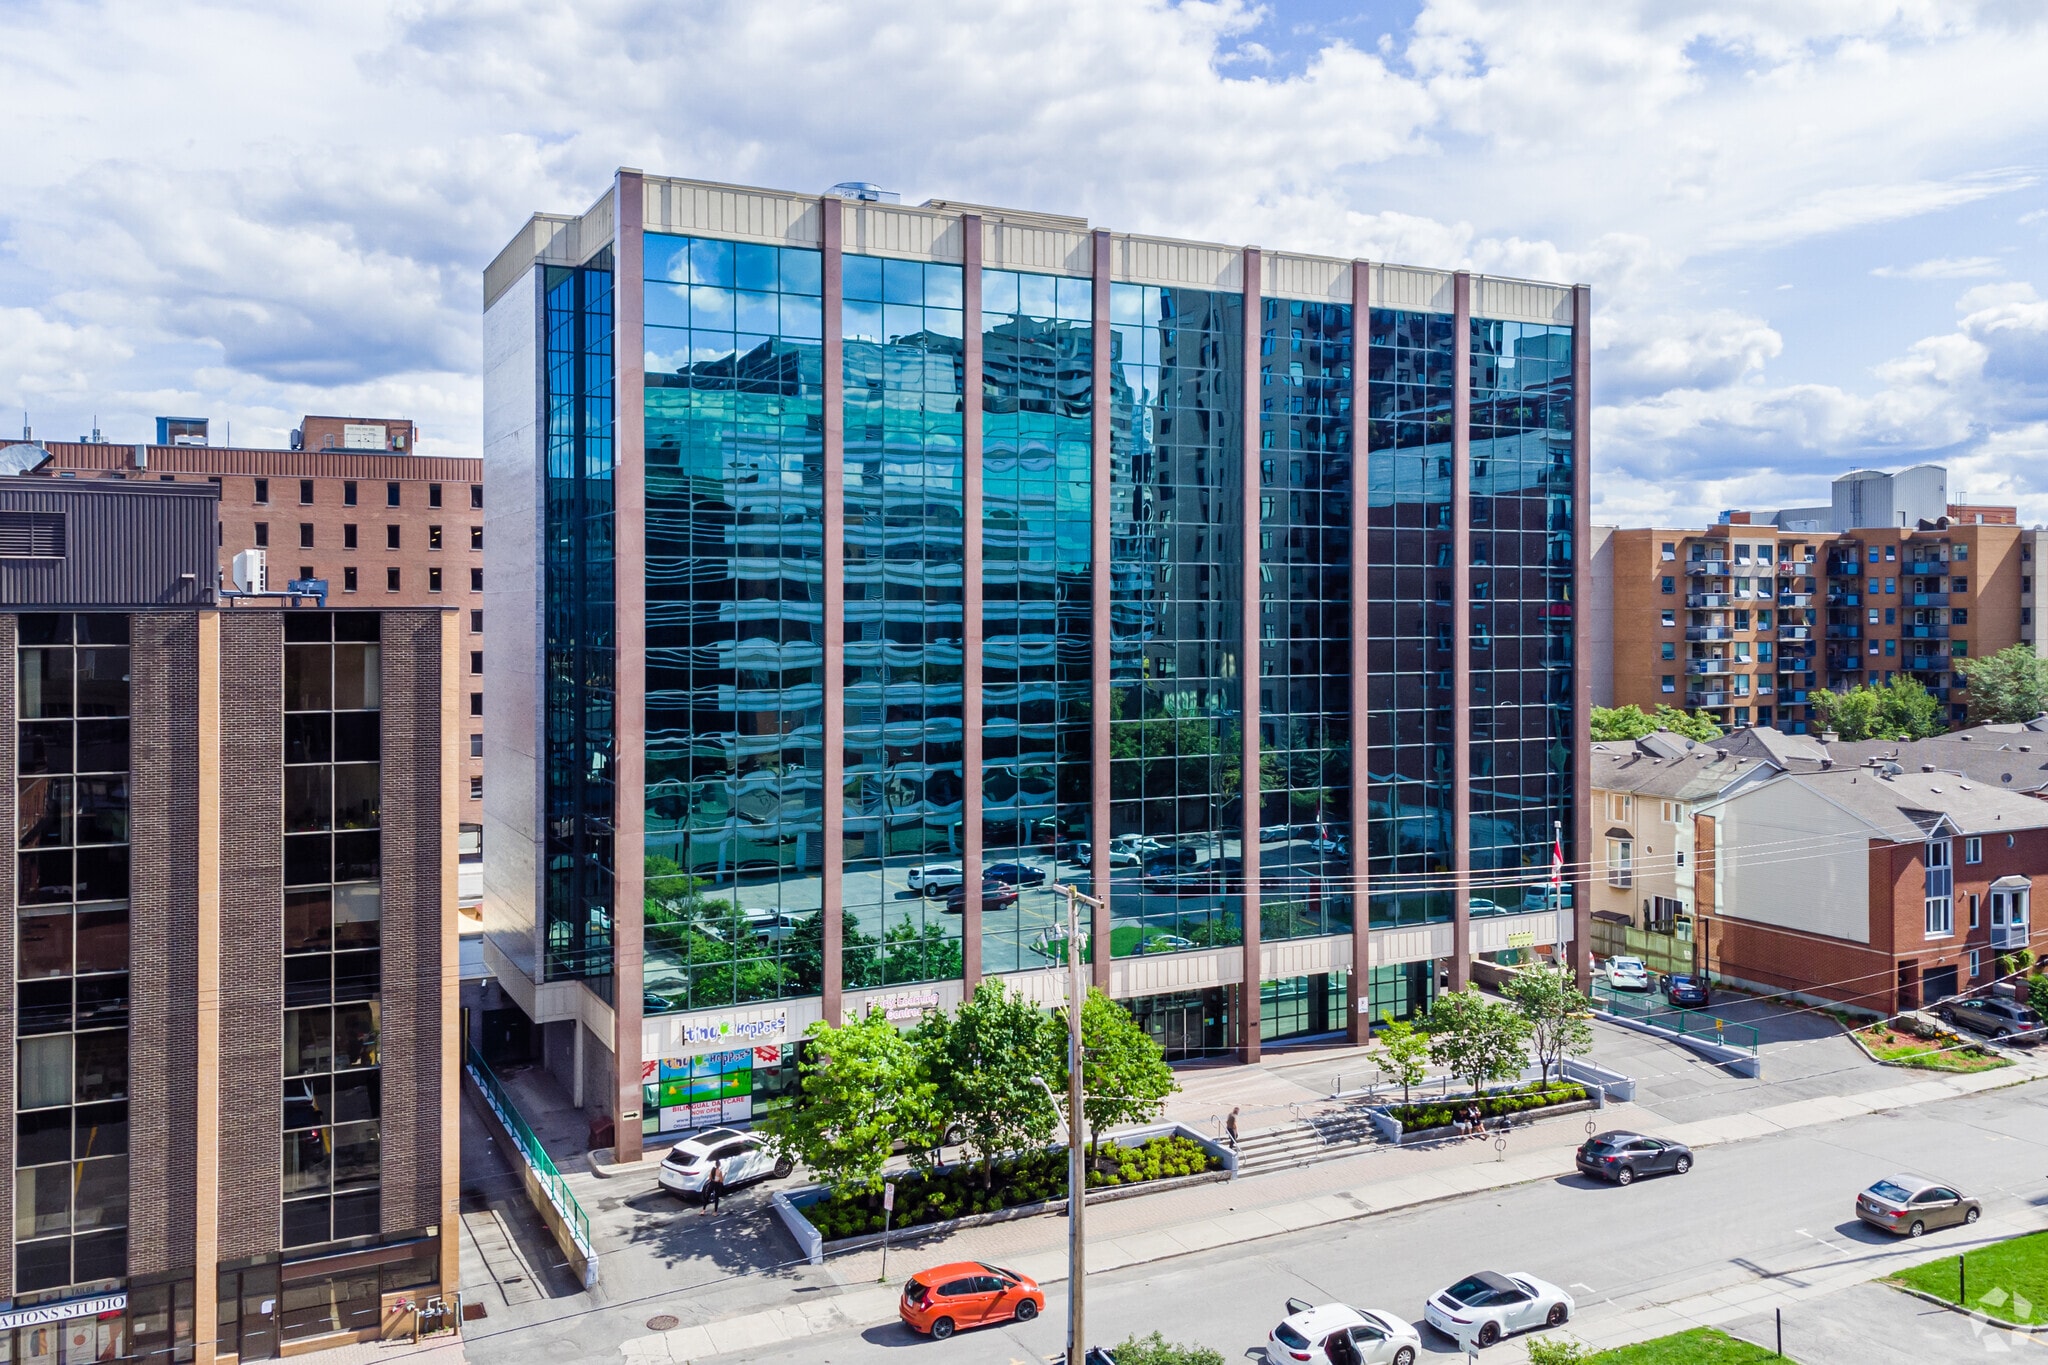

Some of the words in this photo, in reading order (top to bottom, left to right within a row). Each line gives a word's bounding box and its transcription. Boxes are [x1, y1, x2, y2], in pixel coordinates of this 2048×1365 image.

[672, 1102, 710, 1113] BILINGUAL
[711, 1097, 745, 1107] DAYCARE
[691, 1108, 705, 1116] NOW
[71, 1285, 96, 1296] TAILOR
[64, 1297, 124, 1317] STUDIO
